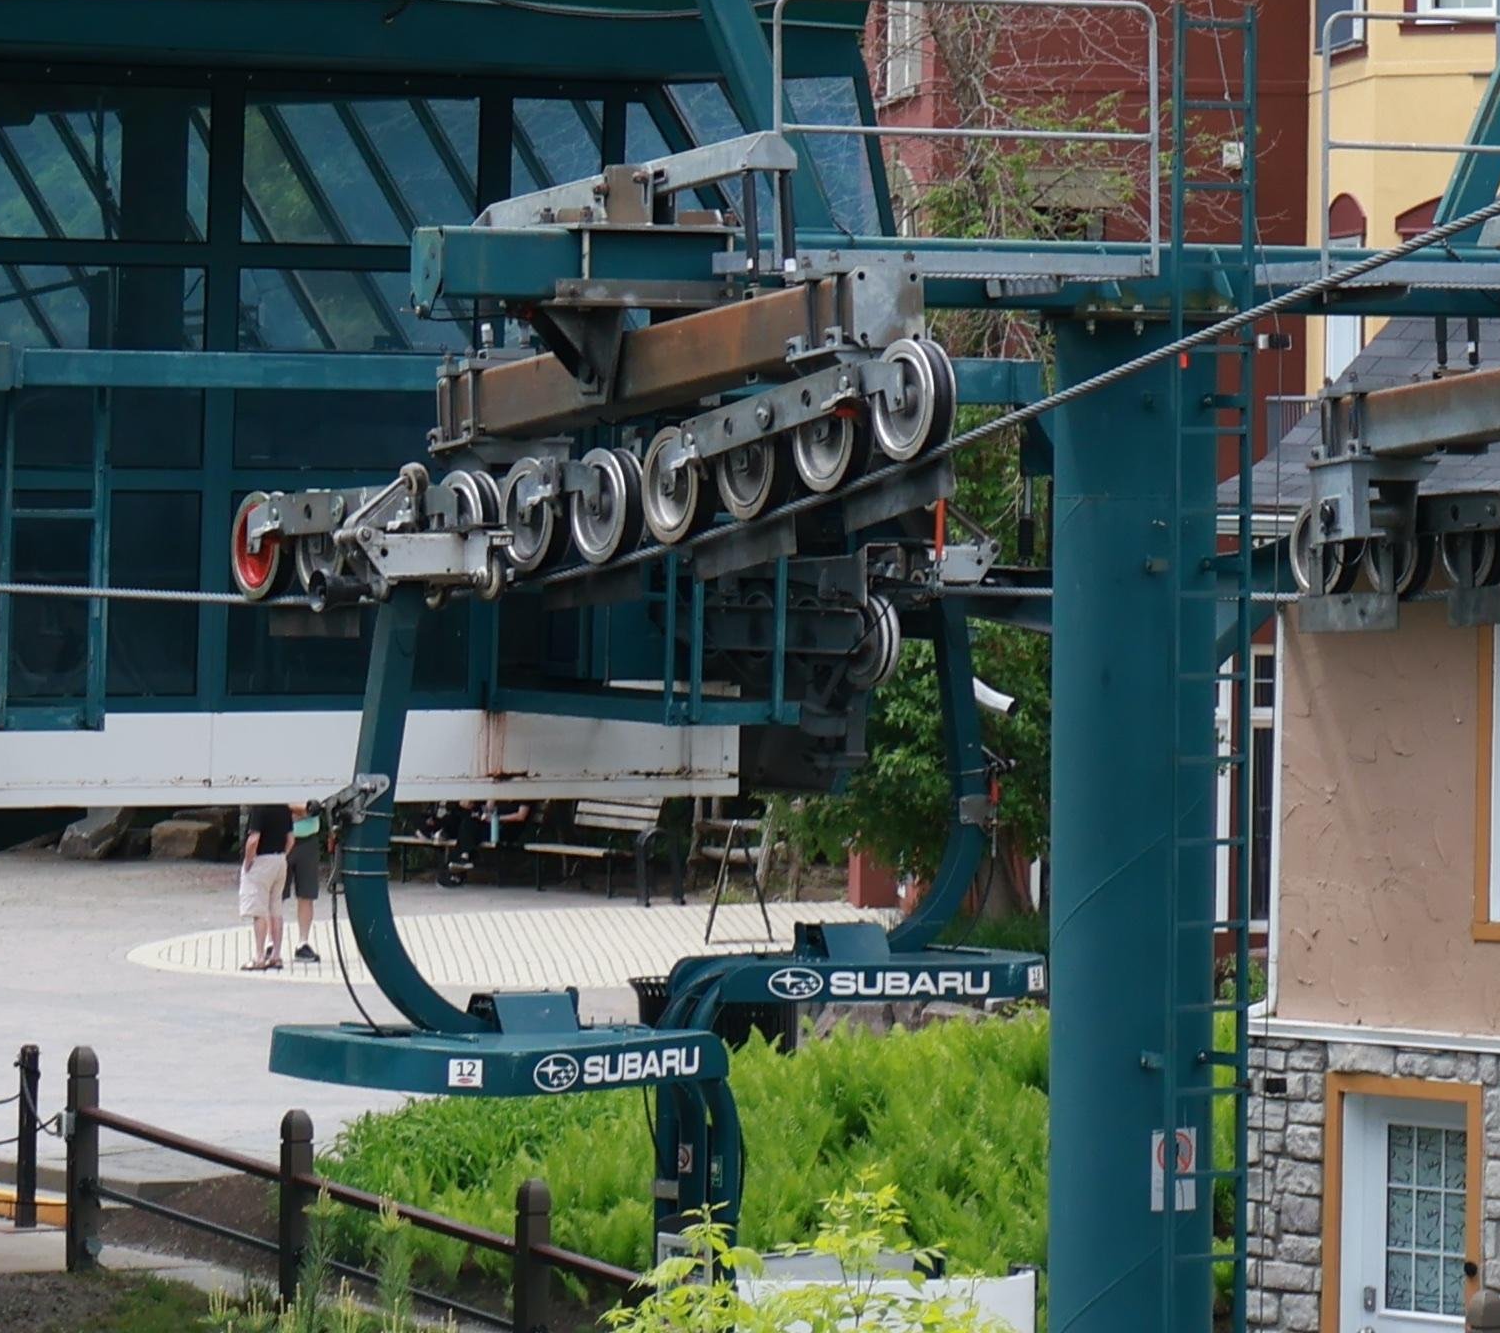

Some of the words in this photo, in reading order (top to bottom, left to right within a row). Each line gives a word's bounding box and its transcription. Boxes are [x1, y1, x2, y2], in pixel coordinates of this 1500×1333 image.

[829, 971, 990, 995] SUBARU
[455, 1060, 477, 1077] 12
[583, 1046, 700, 1084] SUBARU
